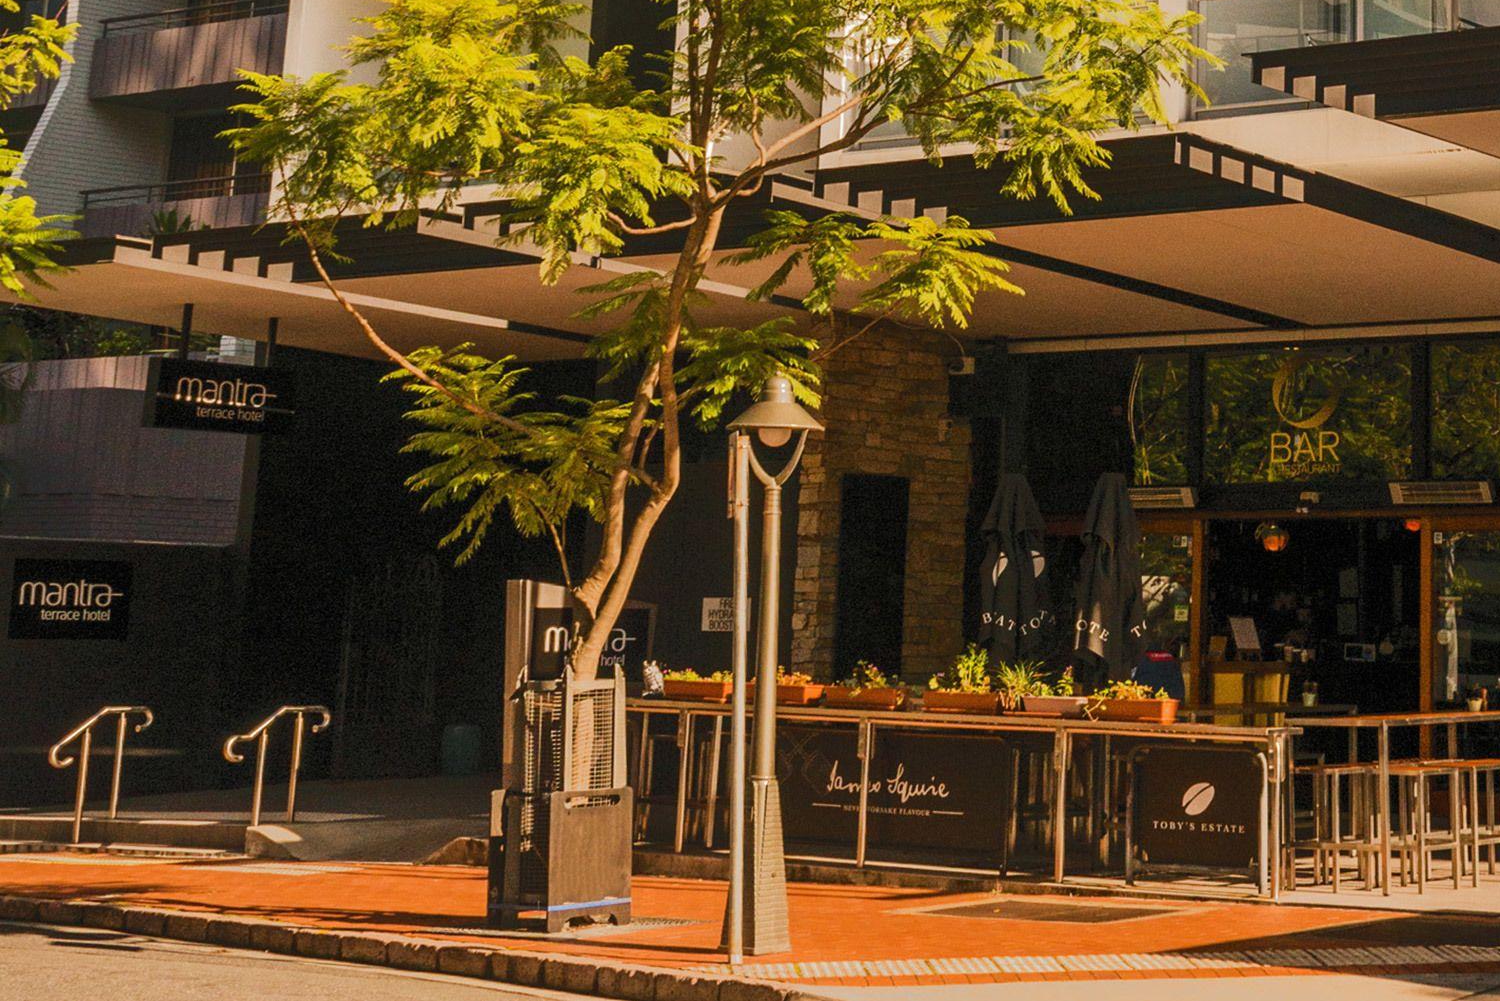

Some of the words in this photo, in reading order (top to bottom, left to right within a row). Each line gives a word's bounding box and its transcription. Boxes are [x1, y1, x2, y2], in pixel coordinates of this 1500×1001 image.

[175, 377, 277, 408] mantra
[196, 407, 235, 420] terrace
[237, 410, 265, 422] hotel
[1270, 431, 1340, 462] BAR
[19, 580, 124, 607] mantra
[41, 609, 80, 620] terrace
[82, 608, 111, 621] hotel
[708, 609, 734, 619] HYDRA
[708, 619, 734, 630] BOOST
[886, 763, 949, 802] Squire
[899, 807, 930, 817] FLAVOUR
[1153, 820, 1196, 831] TOBY'S
[1201, 823, 1245, 834] ESTATE
